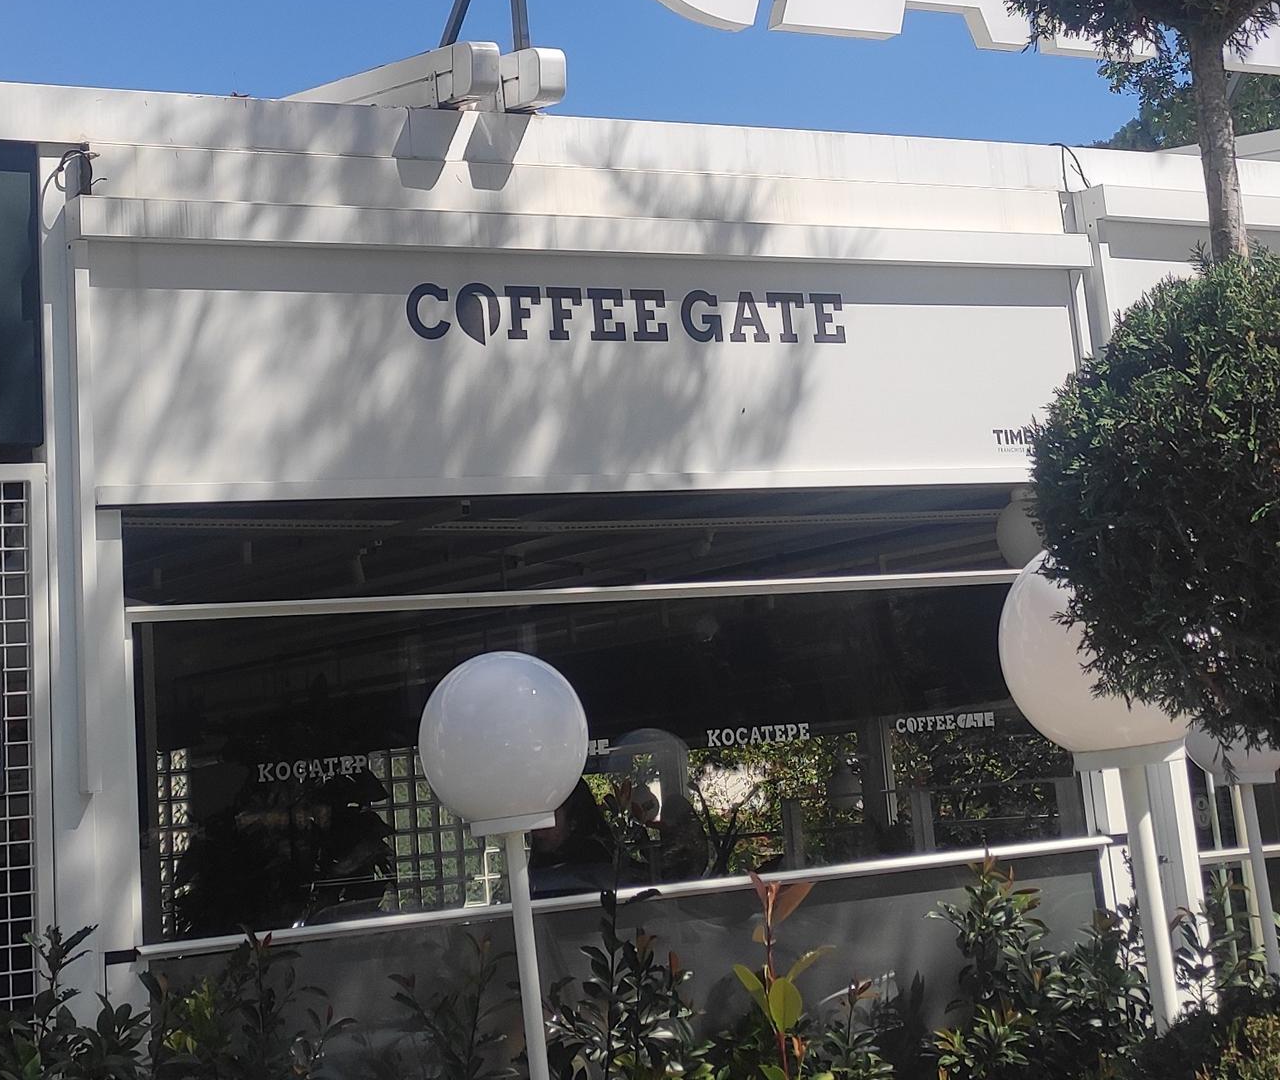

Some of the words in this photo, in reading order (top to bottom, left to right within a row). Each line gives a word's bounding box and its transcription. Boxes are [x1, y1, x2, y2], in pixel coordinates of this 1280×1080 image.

[406, 281, 668, 346] COFFEE
[679, 288, 847, 344] GATE
[706, 723, 811, 748] KOCATEPE
[895, 715, 956, 734] COFFEE
